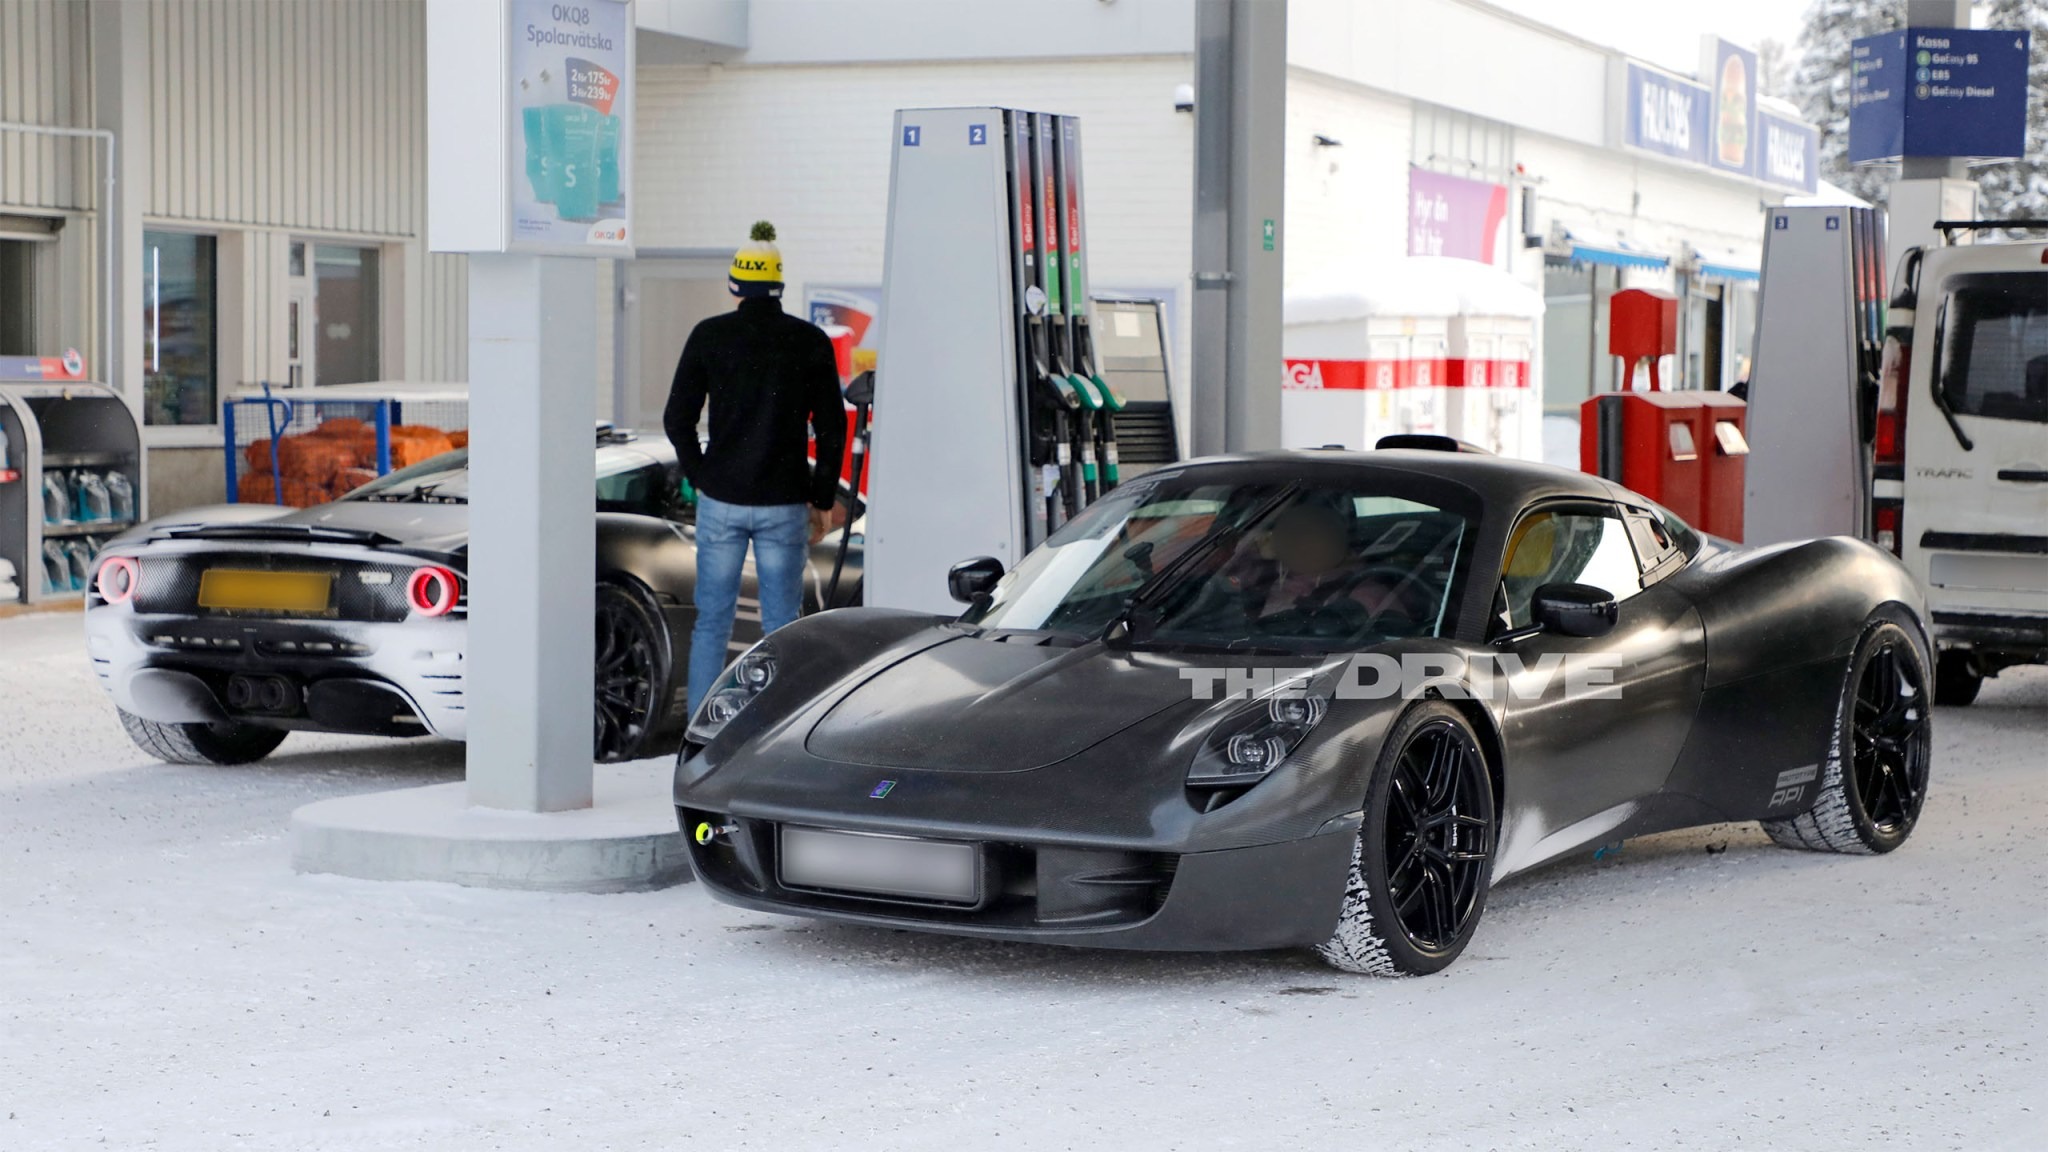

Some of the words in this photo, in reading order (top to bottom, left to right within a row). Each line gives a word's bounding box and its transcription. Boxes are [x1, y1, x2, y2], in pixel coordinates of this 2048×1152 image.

[552, 3, 590, 26] OKQ8
[527, 24, 613, 51] Spolarvätska
[1916, 35, 1950, 49] Kassa
[2014, 38, 2023, 50] 4
[1966, 53, 1979, 65] 95
[571, 68, 578, 81] 2
[571, 84, 578, 97] 3
[1966, 86, 1995, 97] Diesel
[908, 129, 916, 143] 1
[973, 128, 983, 142] 2
[565, 164, 577, 188] S
[1778, 217, 1785, 230] 3
